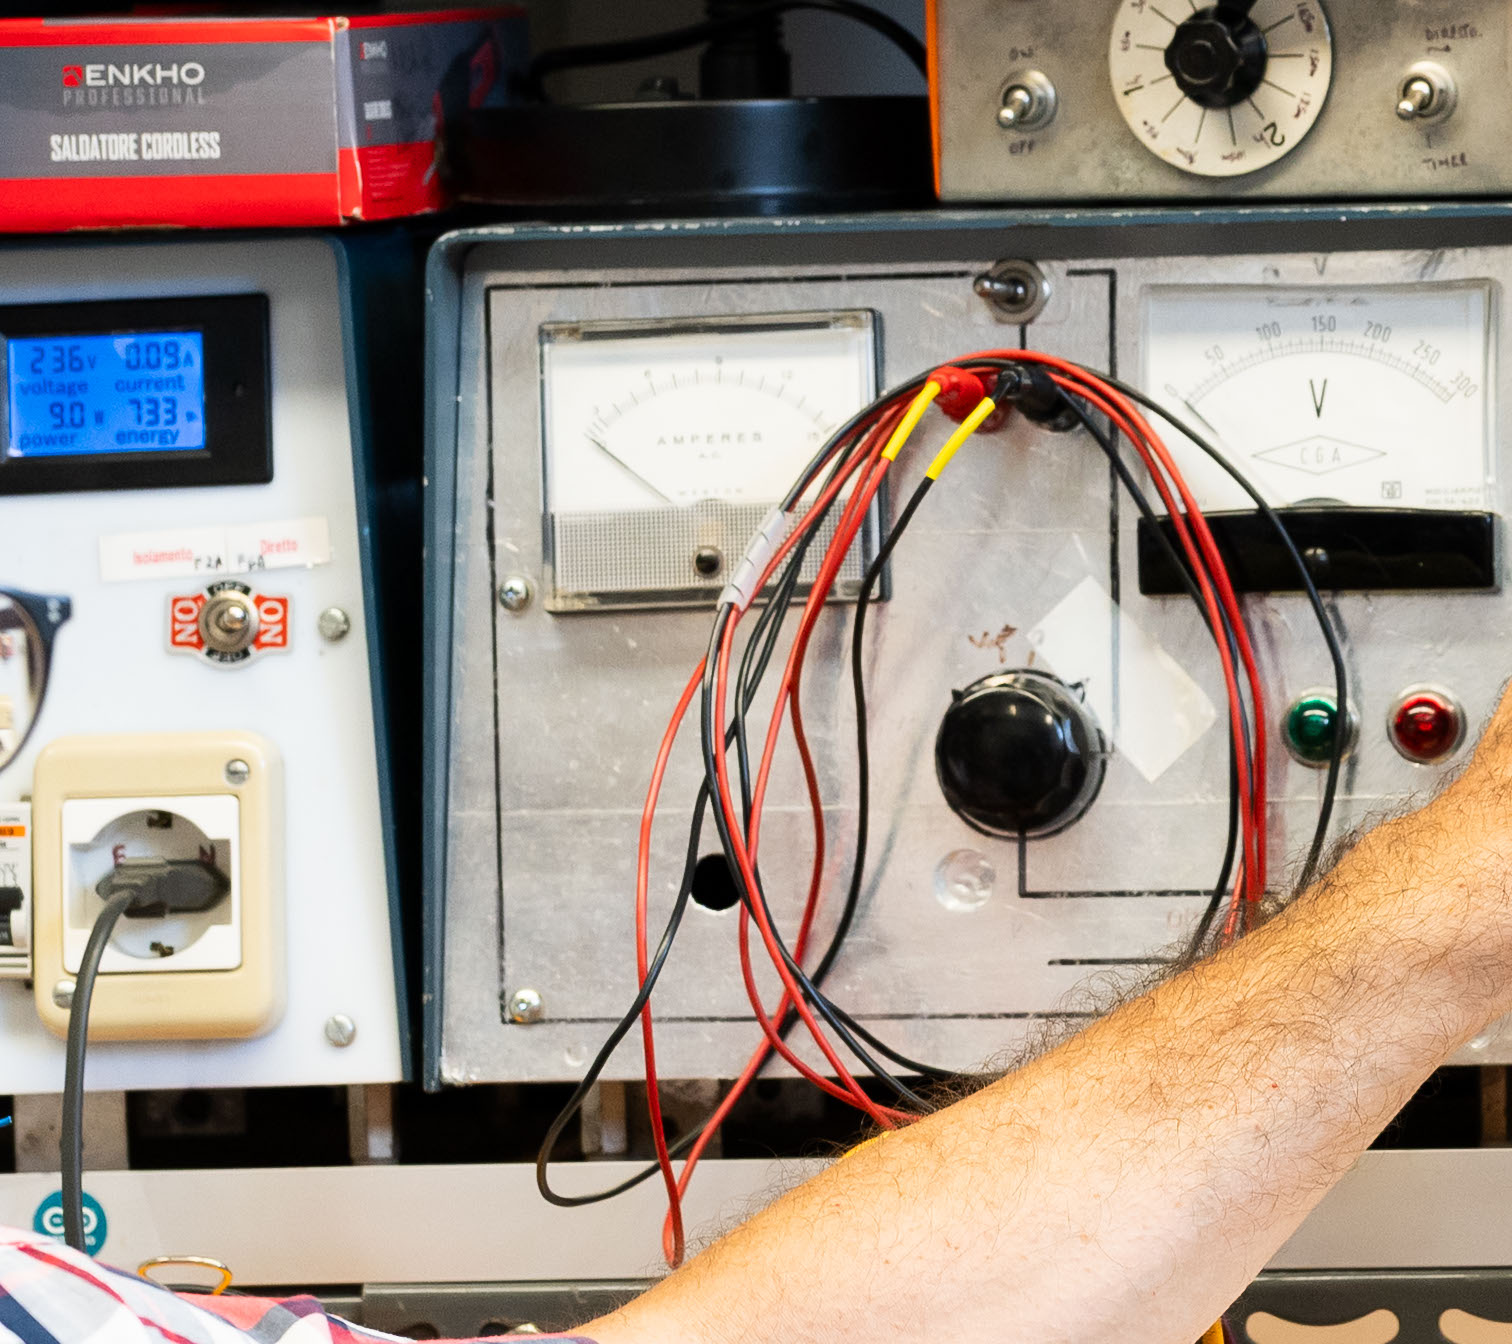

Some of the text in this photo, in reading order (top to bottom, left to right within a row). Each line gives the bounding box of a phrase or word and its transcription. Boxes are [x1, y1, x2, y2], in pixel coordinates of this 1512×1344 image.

[85, 61, 206, 87] ENKHO
[62, 86, 206, 106] PROFESSIONAL
[49, 131, 221, 162] SALDATORE CORDLESS
[1256, 321, 1282, 342] 100
[1312, 315, 1336, 333] 150
[1363, 321, 1392, 343] 200
[1204, 343, 1225, 366] 50
[1412, 338, 1441, 367] 250
[20, 374, 186, 397] voltage current
[1449, 370, 1478, 400] 300
[1309, 377, 1328, 418] V
[20, 428, 181, 450] power energy
[656, 431, 763, 446] AMPERES
[132, 537, 299, 566] Isolamento Diretto
